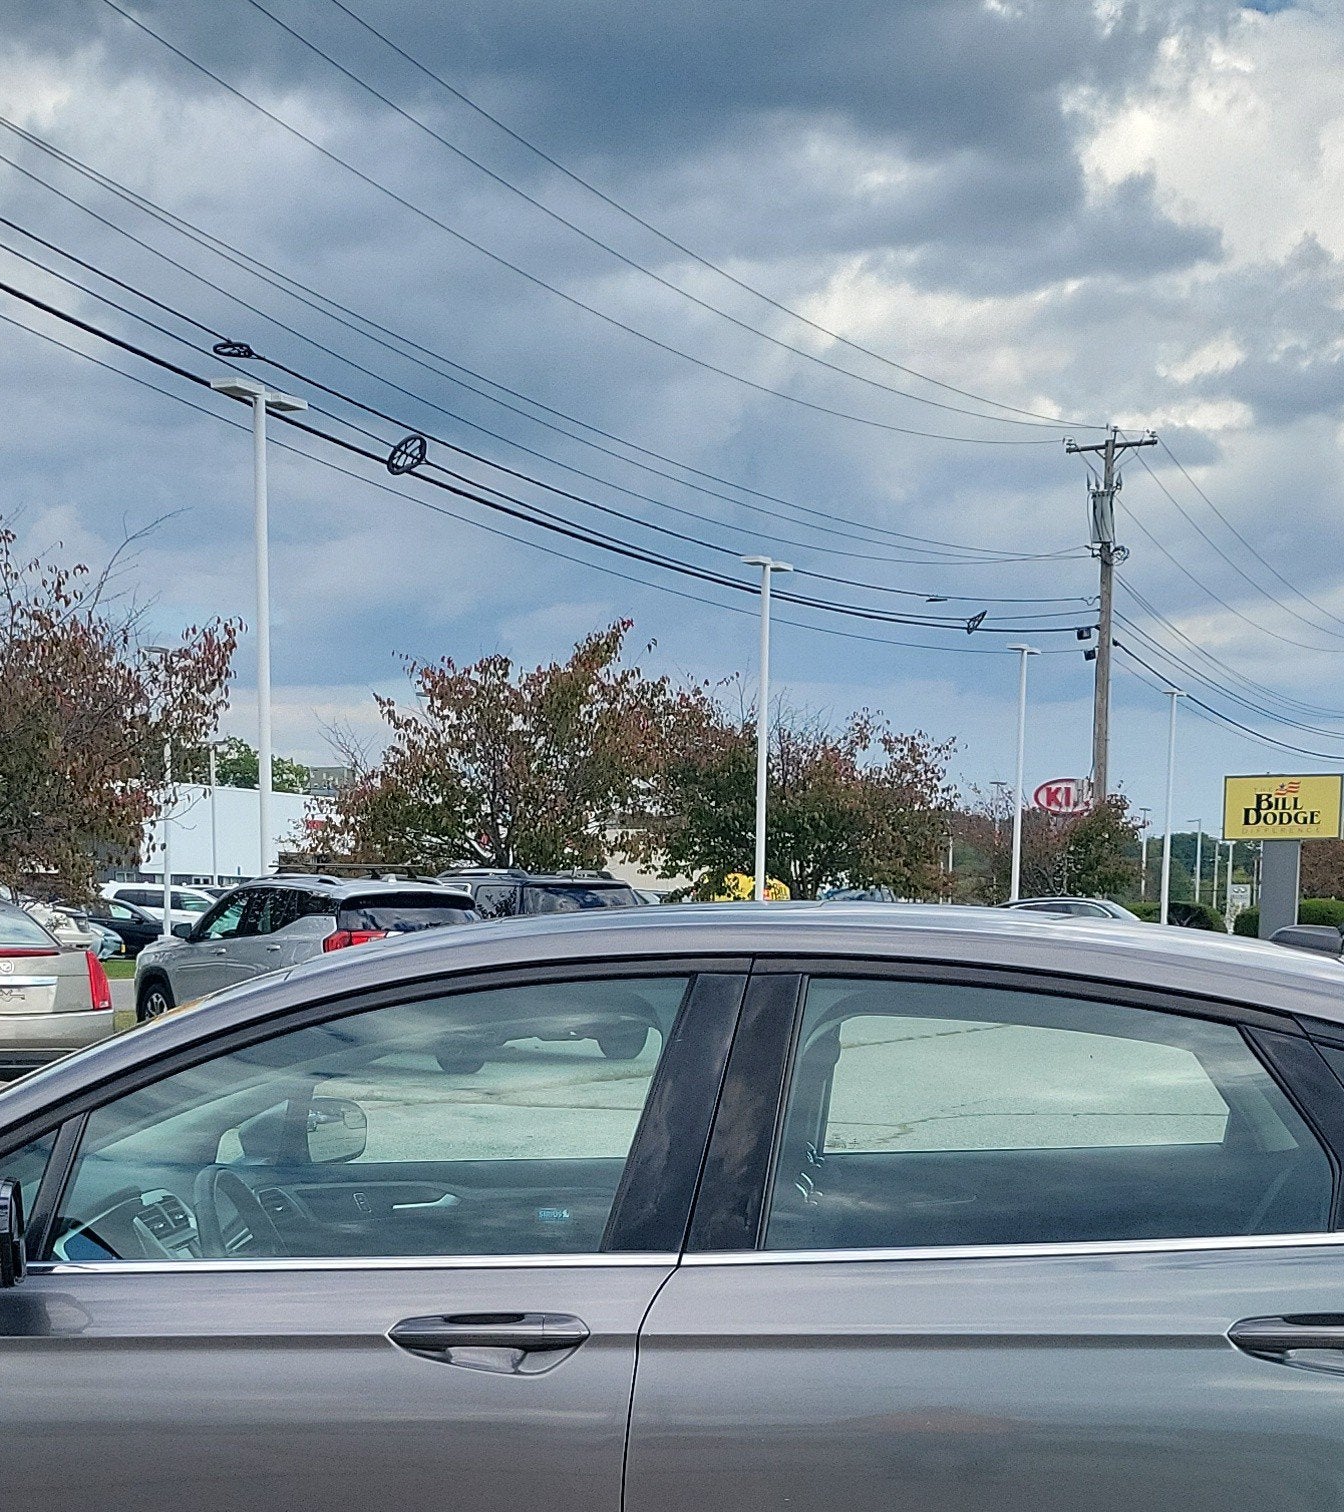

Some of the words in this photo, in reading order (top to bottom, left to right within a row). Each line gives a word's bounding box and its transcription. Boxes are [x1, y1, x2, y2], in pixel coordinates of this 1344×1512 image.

[1255, 793, 1304, 811] BILL
[1242, 807, 1322, 826] DODGE
[1241, 827, 1320, 835] DIFFERENCE
